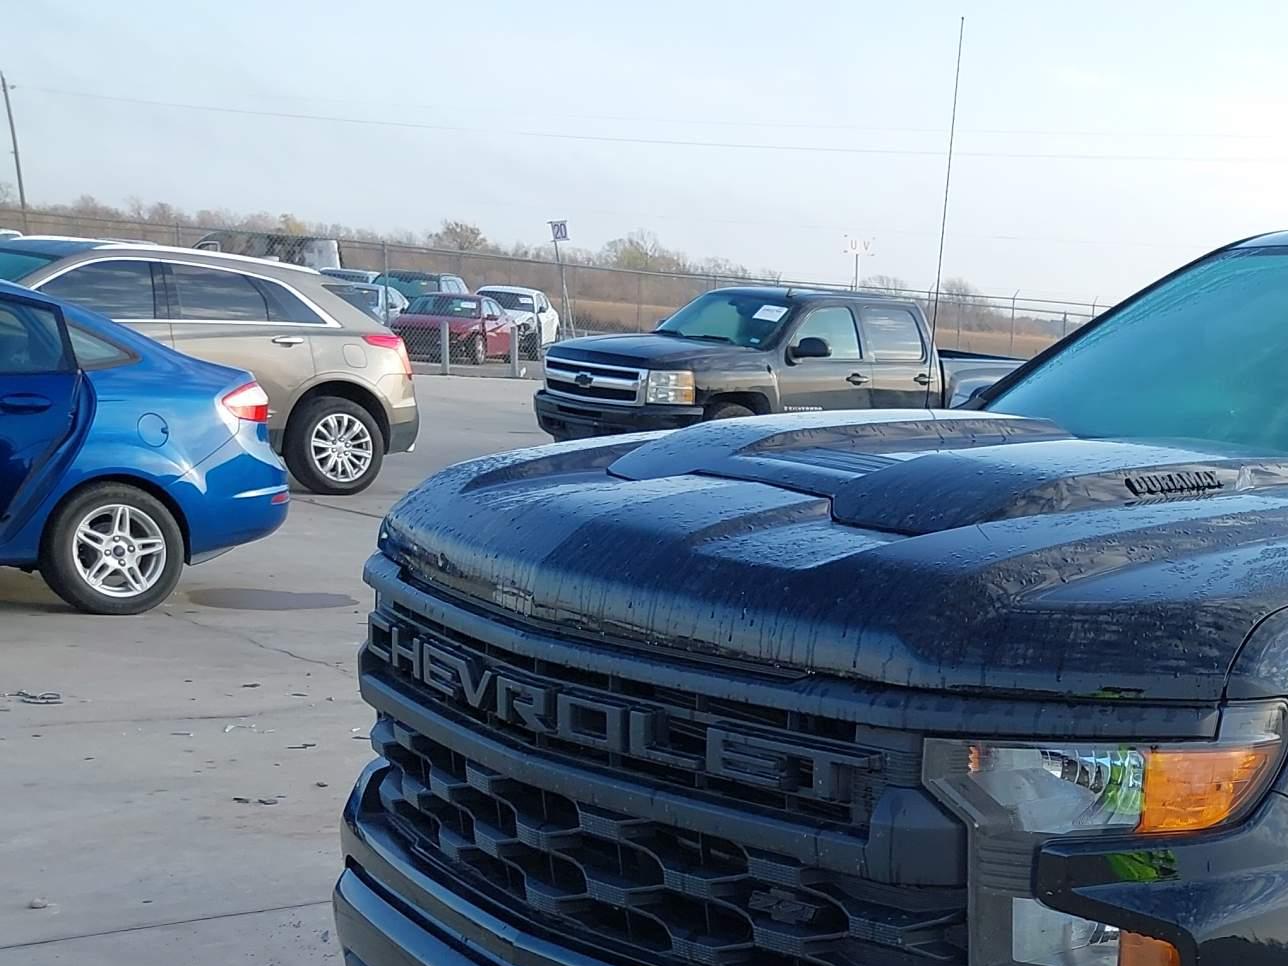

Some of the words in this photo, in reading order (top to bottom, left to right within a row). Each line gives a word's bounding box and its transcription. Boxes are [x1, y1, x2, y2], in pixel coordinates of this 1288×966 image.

[553, 223, 567, 240] 20
[1125, 470, 1224, 496] DURAMAX
[368, 607, 883, 801] CHEVROLET
